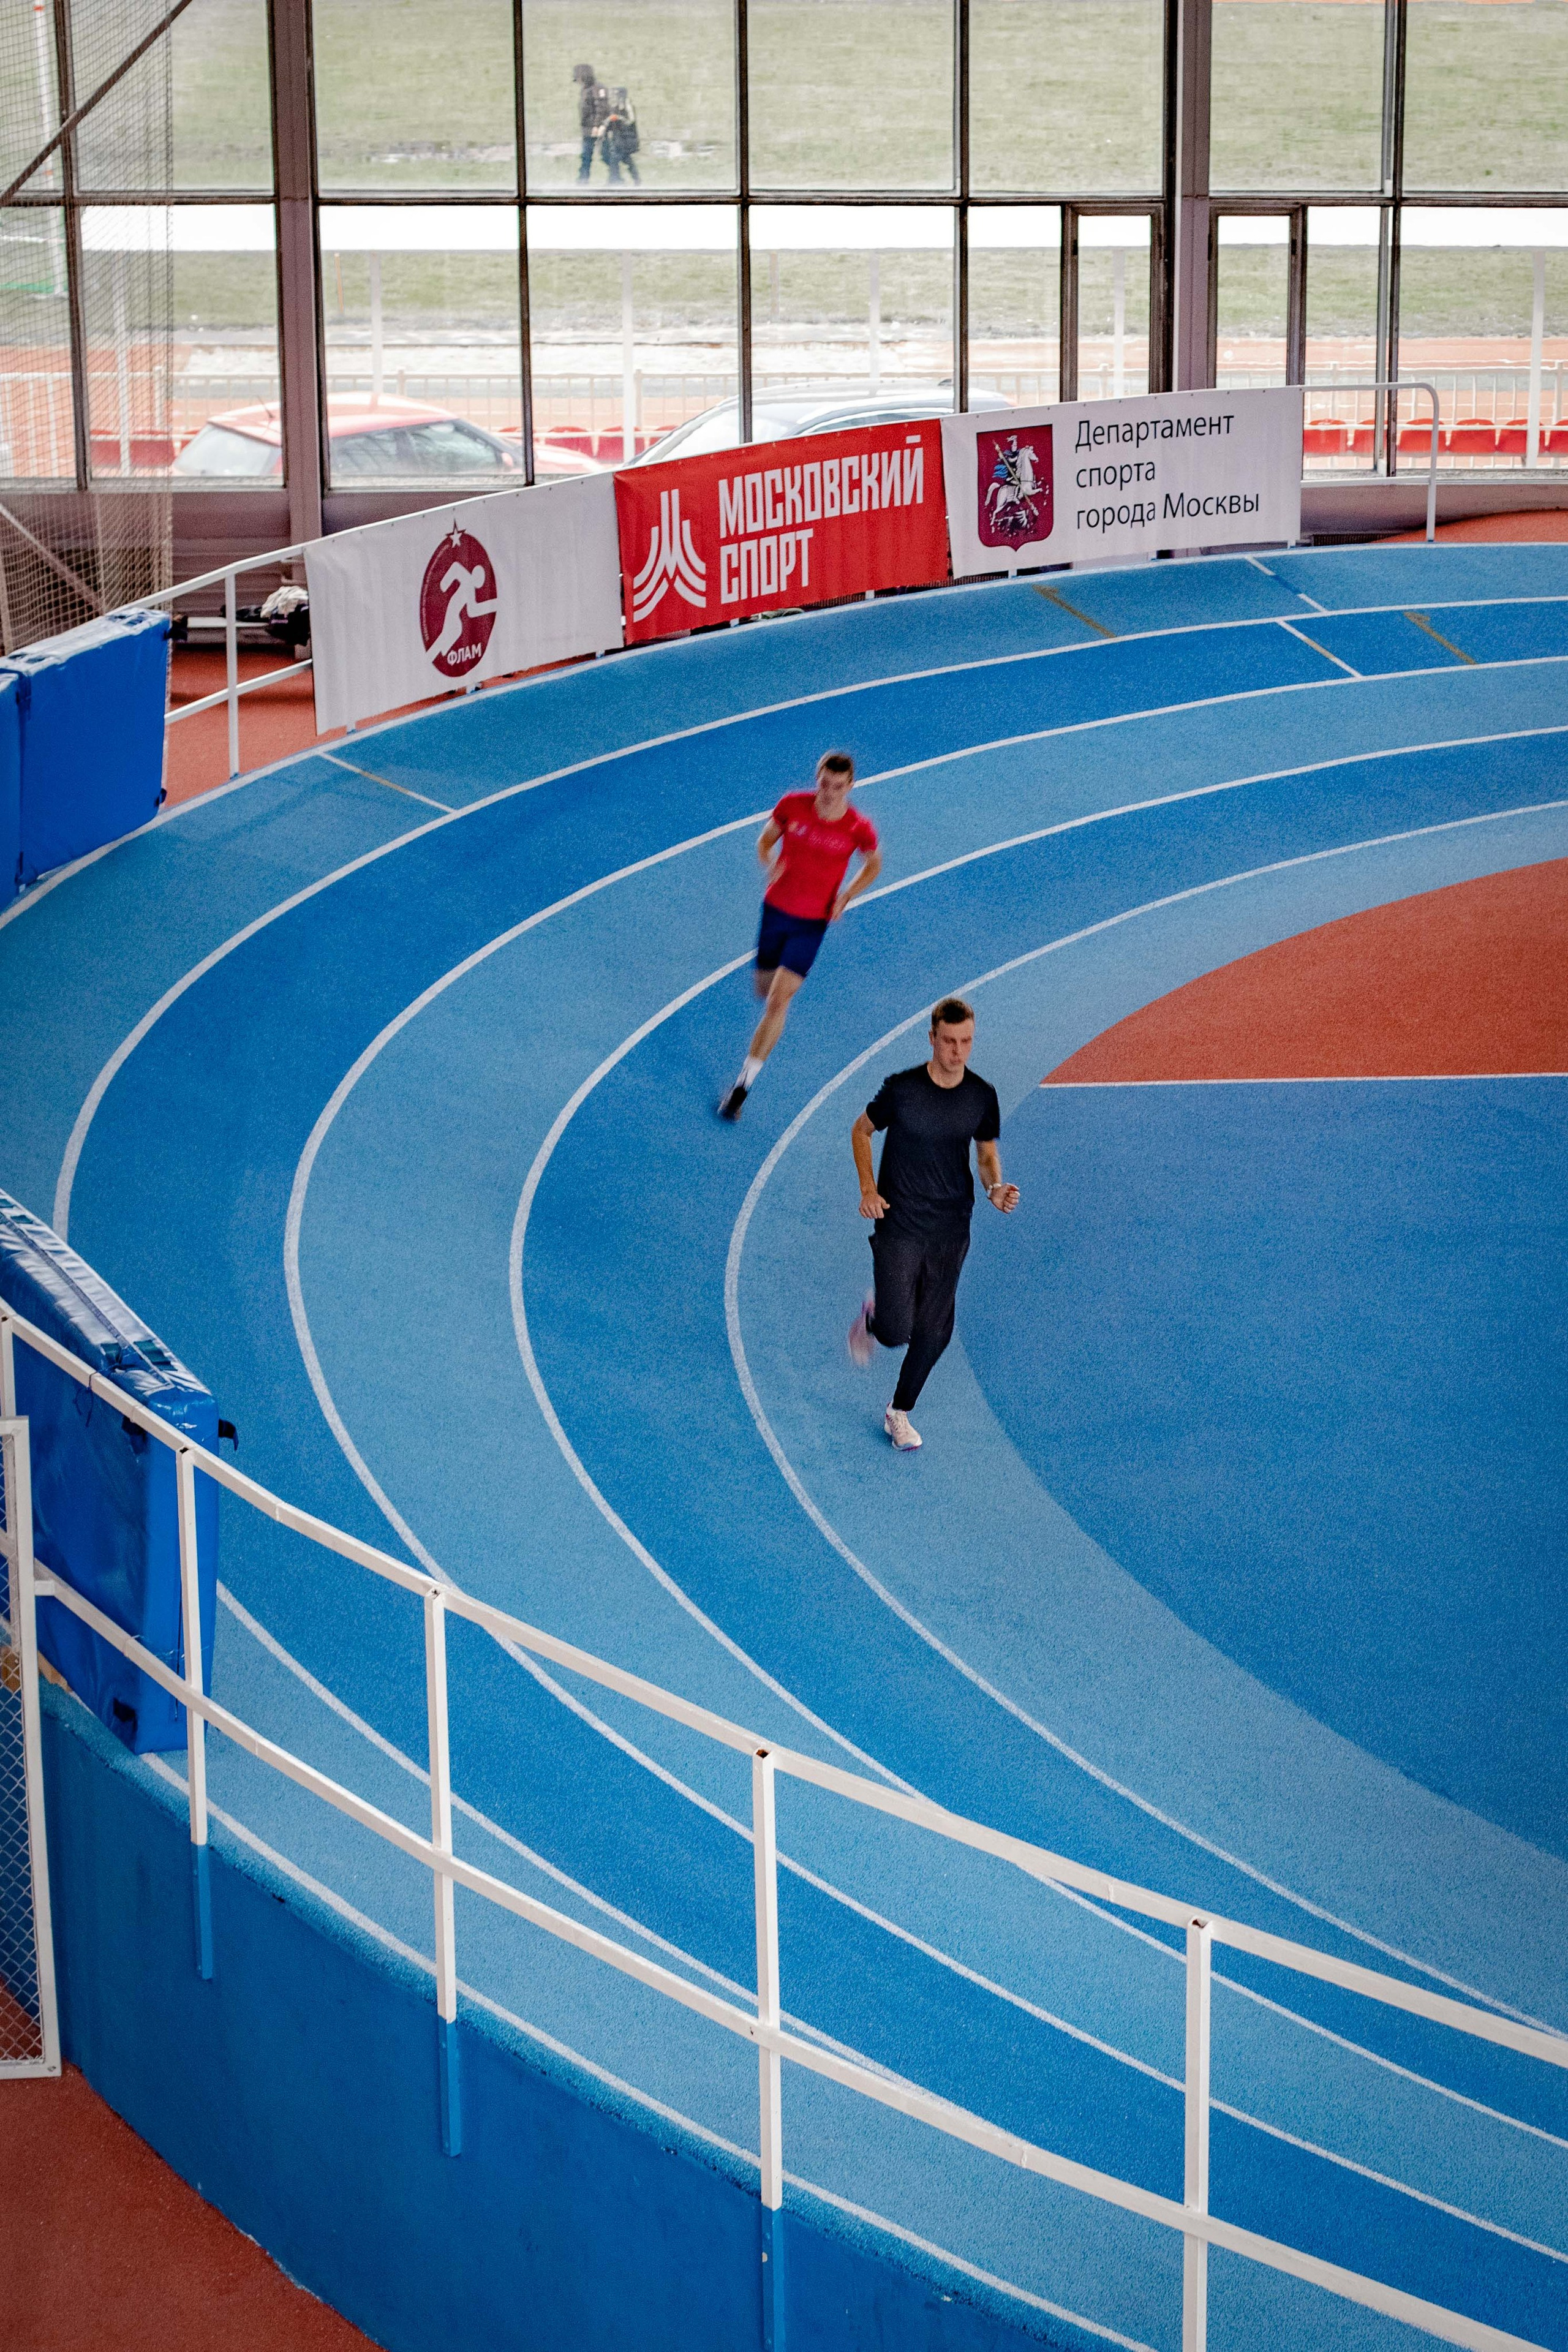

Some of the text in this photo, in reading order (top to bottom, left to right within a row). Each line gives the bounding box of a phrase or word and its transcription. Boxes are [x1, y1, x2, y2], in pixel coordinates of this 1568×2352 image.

[1075, 414, 1235, 453] Департамент
[718, 434, 924, 538] МОСКОВСКИЙ
[1076, 461, 1155, 491] спорта
[1077, 492, 1259, 533] города Москвы
[720, 528, 813, 605] СПОРТ
[447, 642, 482, 666] ФЛАМ
